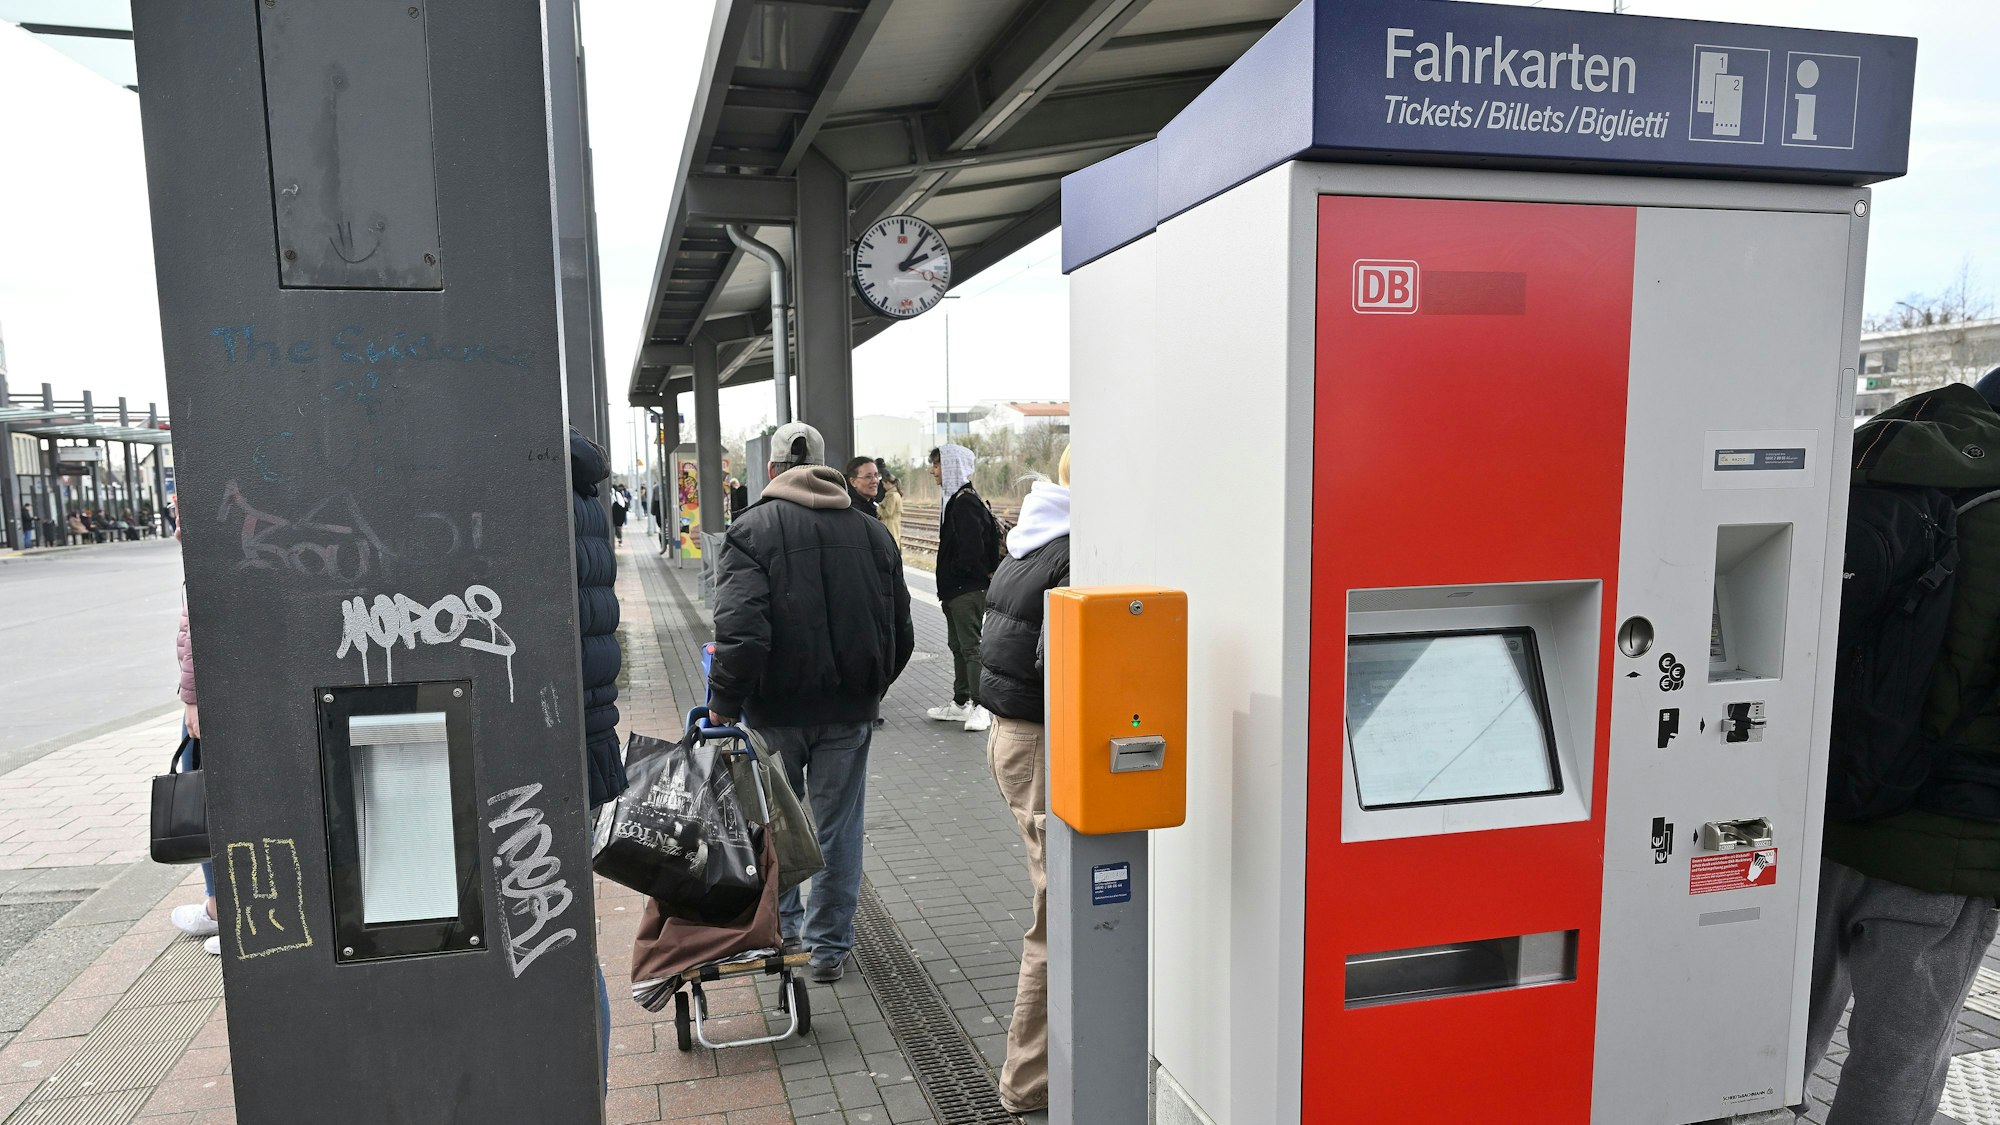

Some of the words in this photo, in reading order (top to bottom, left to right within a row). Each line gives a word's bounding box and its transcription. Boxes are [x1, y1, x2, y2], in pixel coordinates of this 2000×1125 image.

[1384, 27, 1637, 94] Fahrkarten
[1362, 269, 1410, 304] DB
[616, 820, 669, 847] KÖLN
